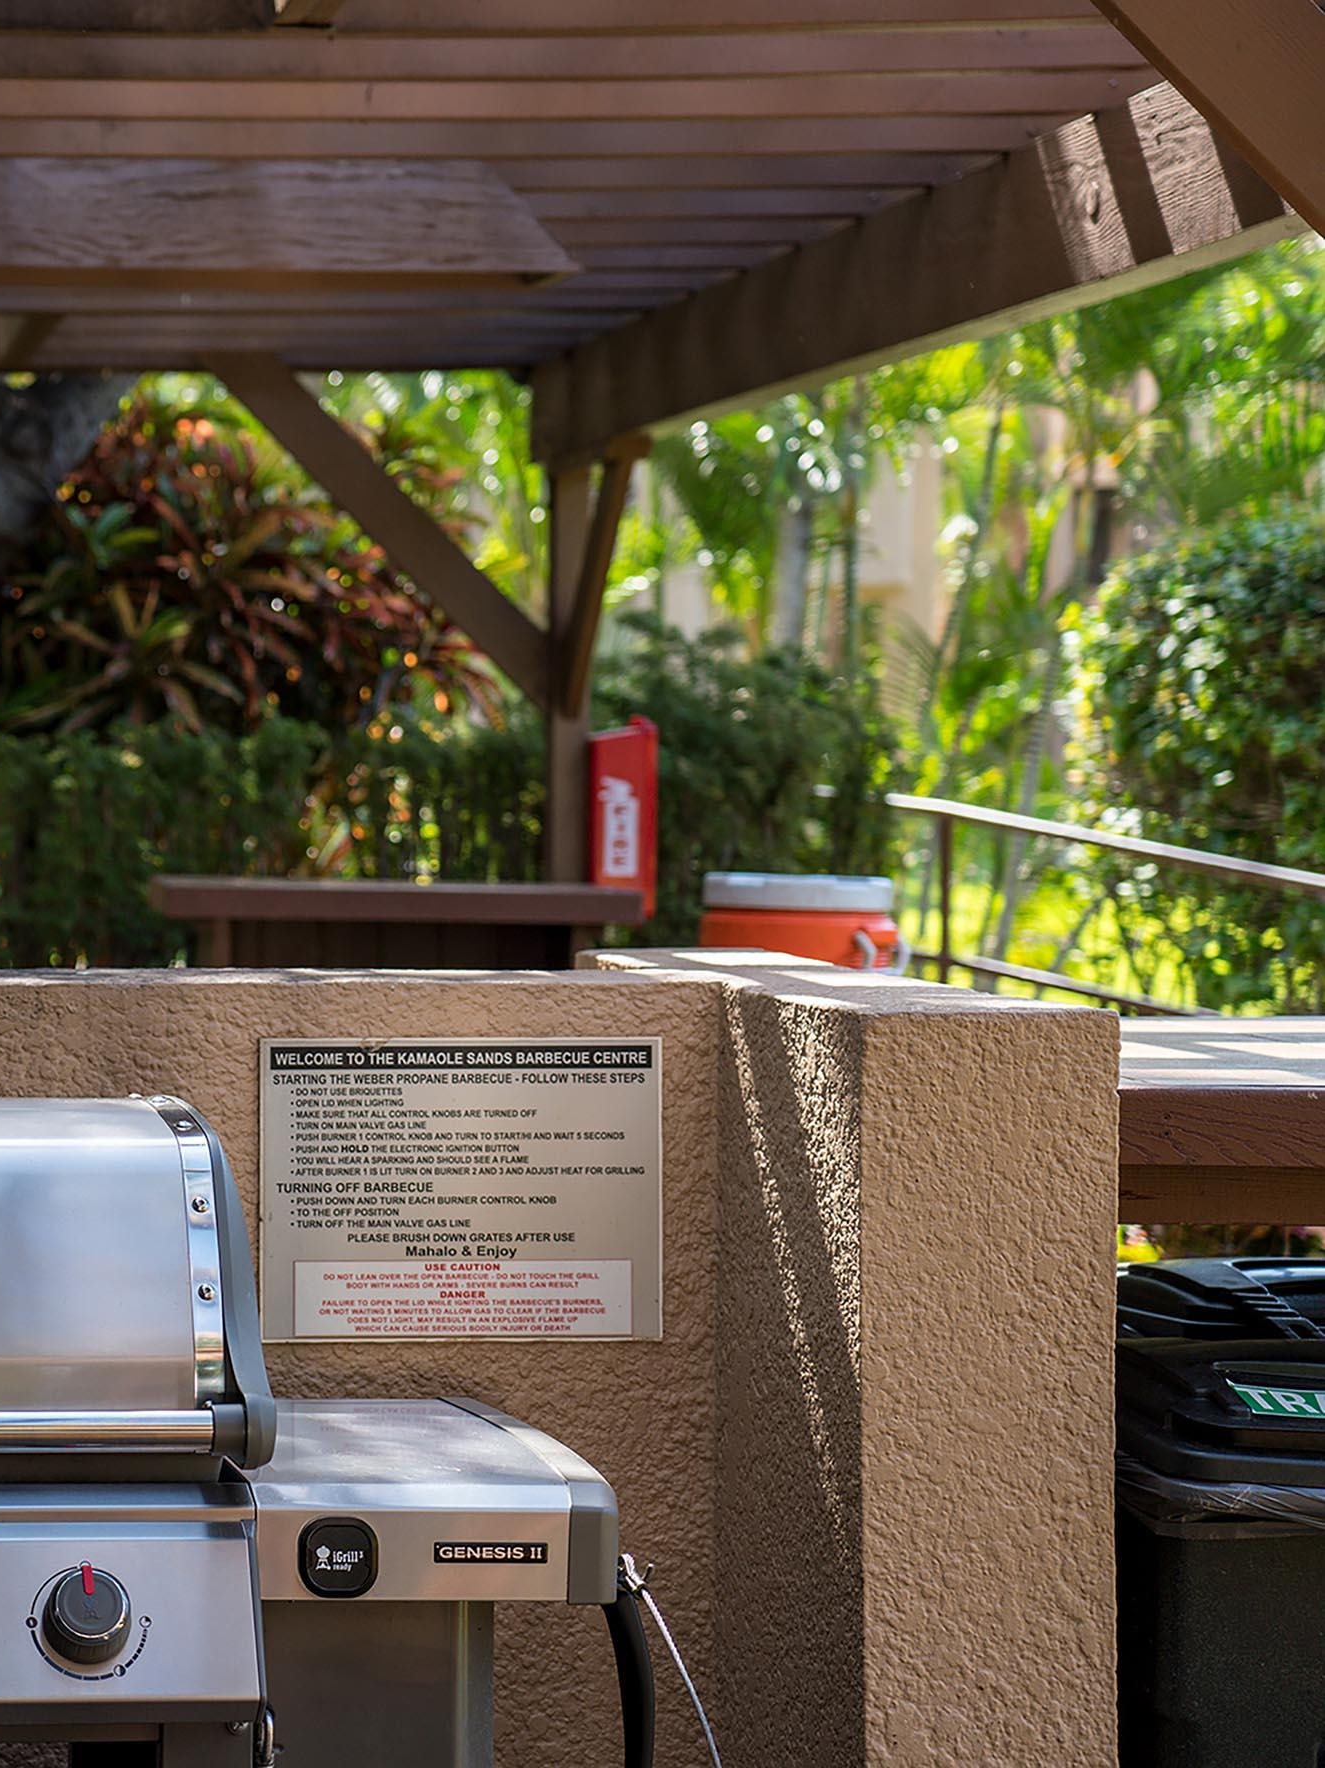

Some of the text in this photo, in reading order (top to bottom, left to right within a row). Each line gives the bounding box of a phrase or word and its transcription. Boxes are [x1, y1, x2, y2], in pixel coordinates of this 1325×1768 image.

[275, 1052, 647, 1065] WELCOME TO THE KAMAOLE SANDS BARBECUE CENTRE
[273, 1074, 326, 1085] STARTING
[329, 1074, 350, 1085] THE
[353, 1074, 394, 1085] WEBER
[396, 1073, 448, 1084] PROPANE
[451, 1073, 512, 1084] BARBECUE
[521, 1073, 568, 1084] FOLLOW
[571, 1073, 606, 1084] THESE
[610, 1073, 645, 1084] STEPS
[295, 1088, 402, 1096] DO NOT USE BRIQUETTES
[296, 1099, 403, 1107] OPEN LID WHEN LIGHTING
[295, 1109, 536, 1118] MAKE SURE THAT ALL CONTROL KNOBS ARE TURNED OFF
[296, 1120, 427, 1130] TURN ON MAIN VALVE GAS LINE
[295, 1133, 319, 1141] PUSH
[320, 1133, 356, 1141] BURNER
[365, 1133, 406, 1141] CONTROL
[407, 1132, 432, 1140] KNOB
[434, 1132, 453, 1140] AND
[454, 1132, 478, 1140] TURN
[480, 1132, 491, 1140] TO
[533, 1132, 551, 1140] AND
[553, 1132, 573, 1140] WAIT
[583, 1132, 624, 1140] SECONDS
[295, 1144, 519, 1153] PUSH AND HOLD THE ELECTRONIC IGNITION BUTTON
[295, 1157, 314, 1165] YOU
[315, 1157, 336, 1165] WILL
[338, 1157, 361, 1165] HEAR
[371, 1157, 414, 1165] SPARKING
[416, 1156, 435, 1164] AND
[436, 1156, 471, 1164] SHOULD
[473, 1156, 490, 1164] SEE
[500, 1156, 528, 1164] FLAME
[295, 1168, 323, 1176] AFTER
[325, 1168, 361, 1176] BURNER
[369, 1168, 378, 1176] IS
[379, 1168, 391, 1176] LIT
[395, 1168, 417, 1176] TURN
[420, 1167, 432, 1175] ON
[434, 1167, 470, 1175] BURNER
[478, 1167, 497, 1175] AND
[505, 1167, 524, 1175] AND
[525, 1167, 558, 1175] ADJUST
[560, 1167, 582, 1175] HEAT
[584, 1167, 602, 1175] FOR
[604, 1167, 644, 1175] GRILLING
[276, 1183, 433, 1193] TURNING OFF BARBECUE
[296, 1196, 556, 1205] PUSH DOWN AND TURN EACH BURNER CONTROL KNOB
[297, 1208, 398, 1217] TO THE OFF POSITION
[297, 1219, 470, 1228] TURN OFF THE MAIN VALVE GAS LINE
[347, 1232, 574, 1243] PLEASE BRUSH DOWN GRATES AFTER USE
[405, 1245, 457, 1256] Mahalo
[476, 1245, 516, 1258] Enjoy
[424, 1263, 500, 1271] USE CAUTION
[439, 1547, 542, 1559] GENESIS II
